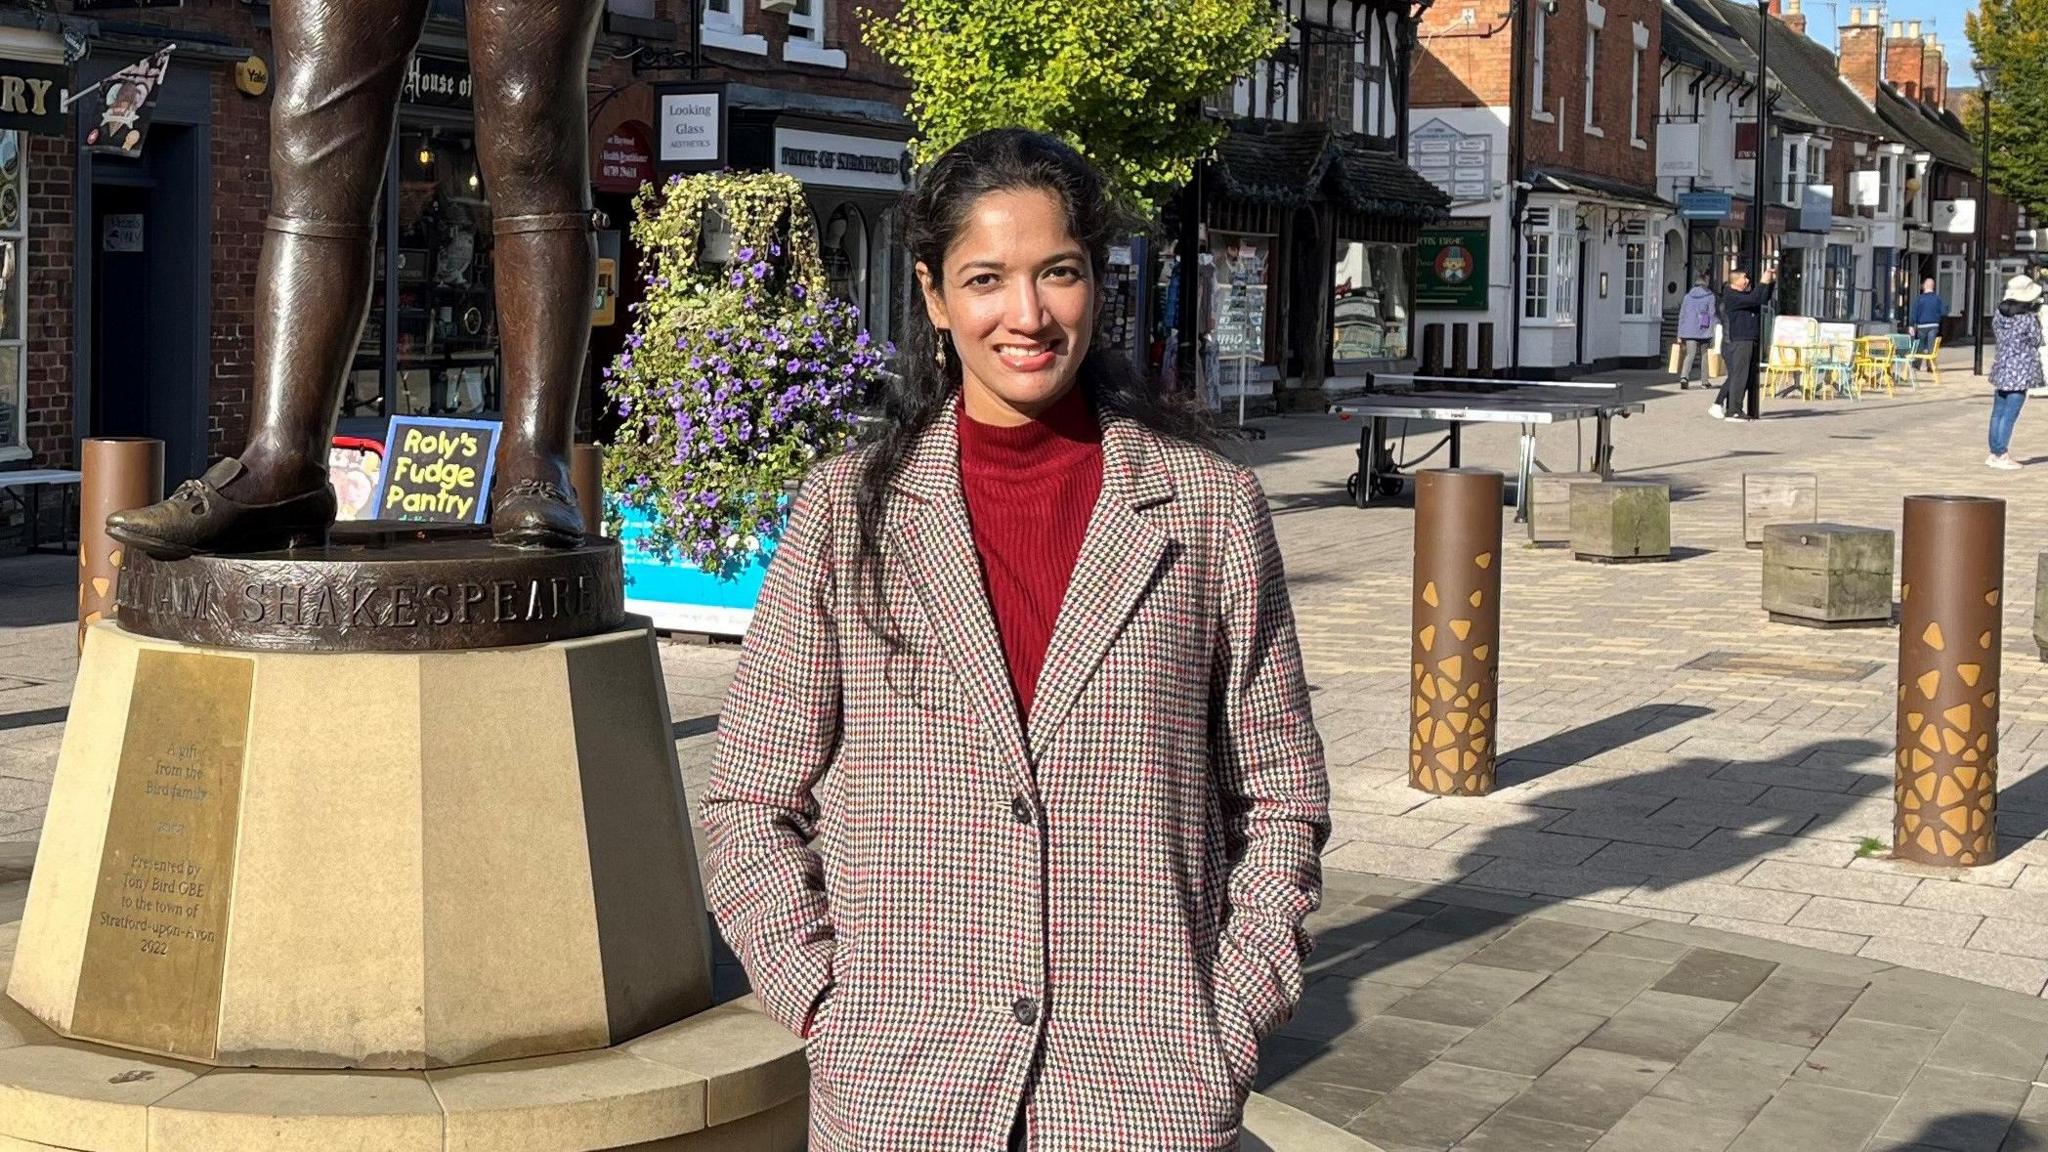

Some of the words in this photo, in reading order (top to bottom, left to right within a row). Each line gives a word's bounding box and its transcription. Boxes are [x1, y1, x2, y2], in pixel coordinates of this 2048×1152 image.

[404, 57, 454, 103] House
[0, 76, 53, 115] RY
[669, 103, 712, 118] Looking
[675, 123, 705, 135] Glass
[404, 428, 478, 460] Roly's
[394, 456, 476, 490] Fudge
[386, 484, 473, 520] Pantry
[243, 575, 595, 629] SHAKESPEARE
[155, 760, 183, 777] from
[185, 765, 204, 780] the
[145, 780, 169, 796] Bird
[131, 855, 185, 875] Presented
[187, 863, 200, 879] by
[122, 872, 149, 894] Tony
[152, 877, 176, 894] Bird
[178, 881, 205, 898] OBE
[135, 896, 154, 912] the
[155, 899, 183, 916] town
[185, 903, 200, 919] of
[100, 911, 216, 943] Stratford-upon-Avon
[140, 938, 168, 956] 2022
